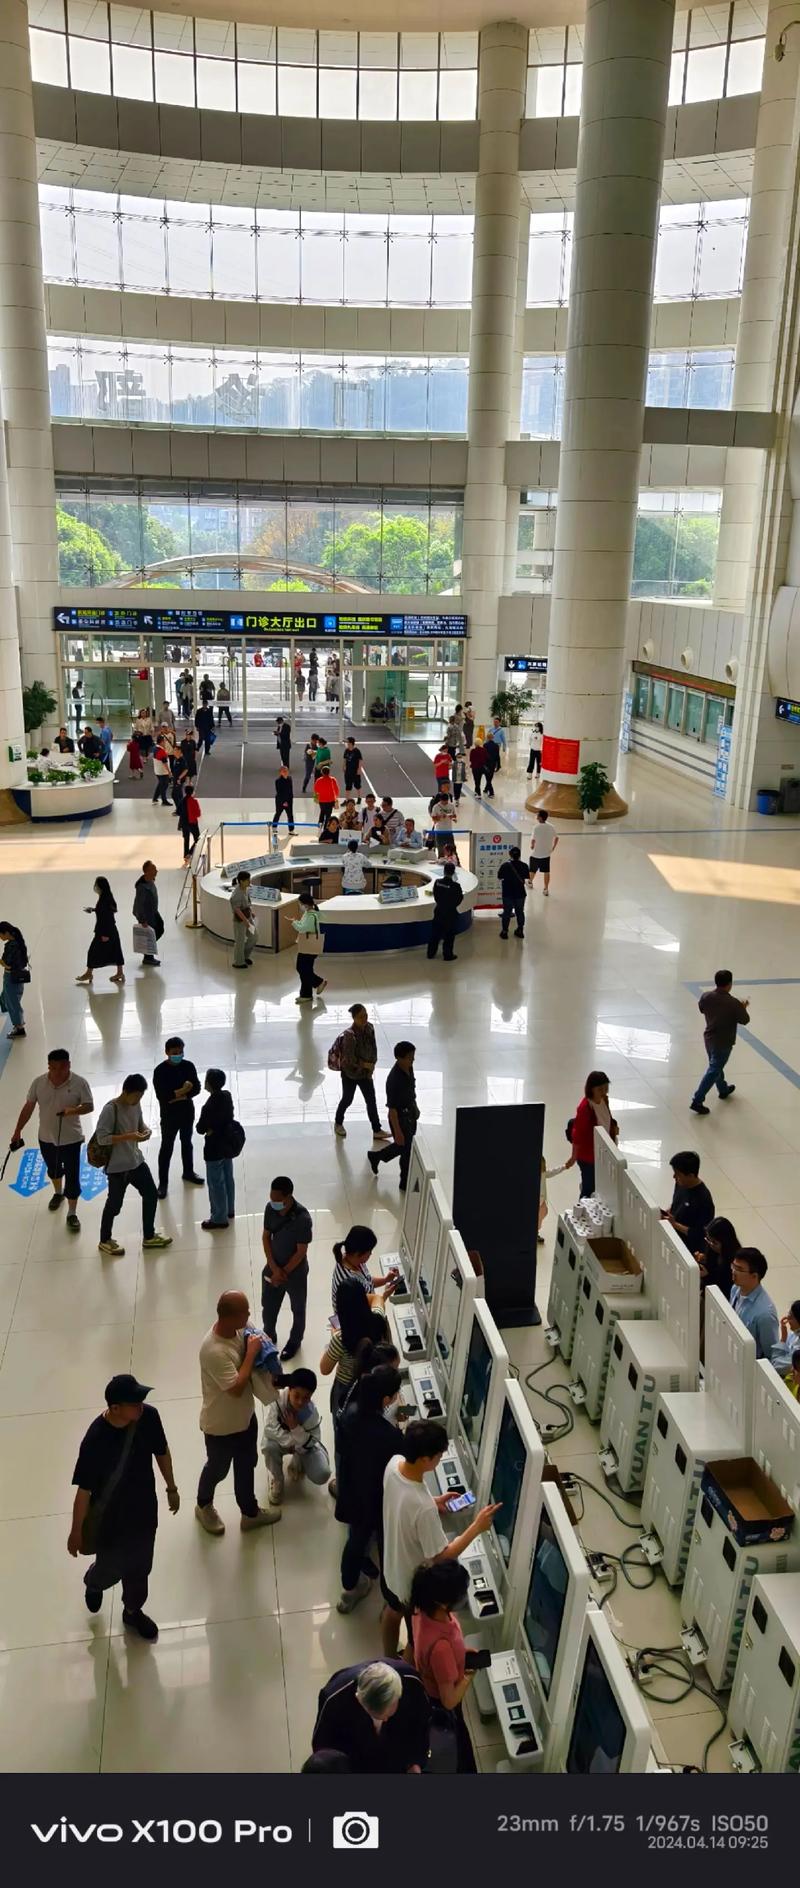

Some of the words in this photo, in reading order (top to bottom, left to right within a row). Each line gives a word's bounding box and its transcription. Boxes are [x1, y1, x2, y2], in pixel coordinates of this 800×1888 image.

[245, 615, 317, 629] 门诊大厅出口
[628, 1420, 651, 1489] YUAN
[640, 1374, 656, 1415] TU
[738, 1556, 759, 1600] TU
